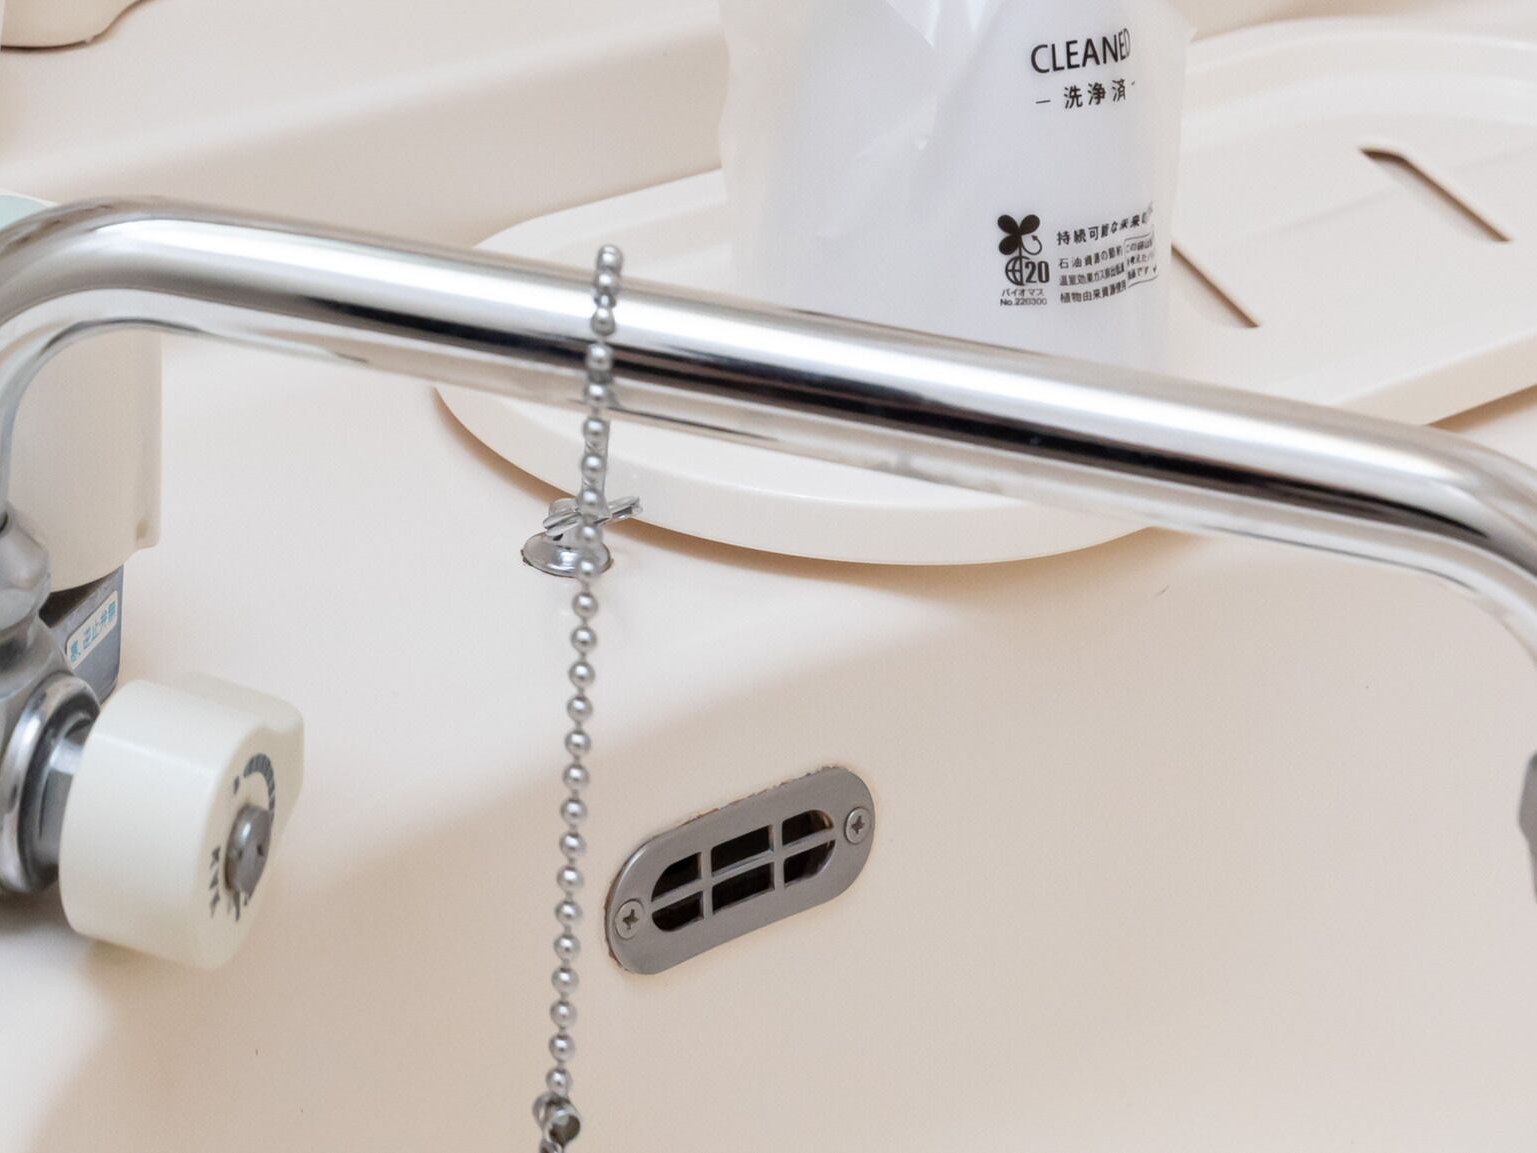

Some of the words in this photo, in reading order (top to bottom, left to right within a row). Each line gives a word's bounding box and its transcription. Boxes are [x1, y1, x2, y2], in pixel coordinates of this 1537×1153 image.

[1030, 28, 1132, 75] CLEANED
[1001, 288, 1045, 297] バイオマス
